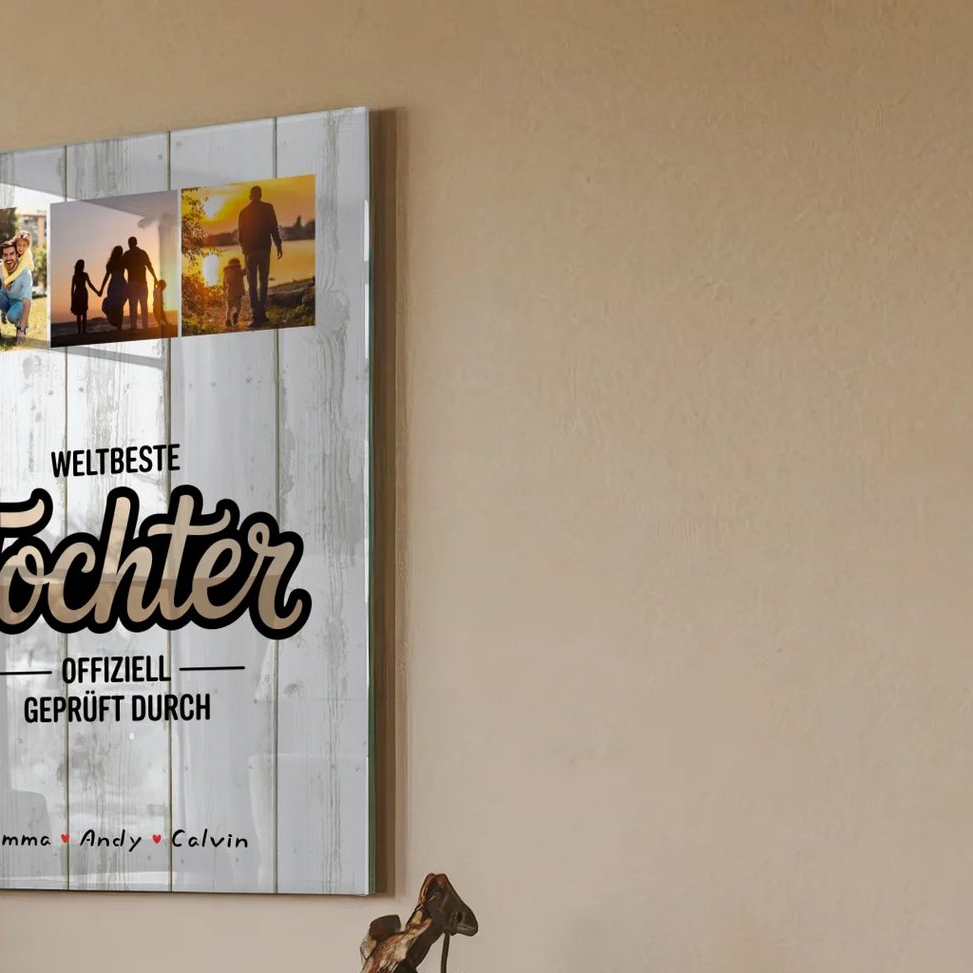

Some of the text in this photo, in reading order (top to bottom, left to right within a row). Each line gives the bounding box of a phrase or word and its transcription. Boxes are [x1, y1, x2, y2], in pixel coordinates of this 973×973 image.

[51, 444, 180, 477] WELTBESTE
[62, 655, 171, 684] OFFIZIELL
[24, 691, 211, 723] GEPRÜFT DURCH
[80, 829, 142, 852] Andy
[172, 829, 248, 848] Calvin
